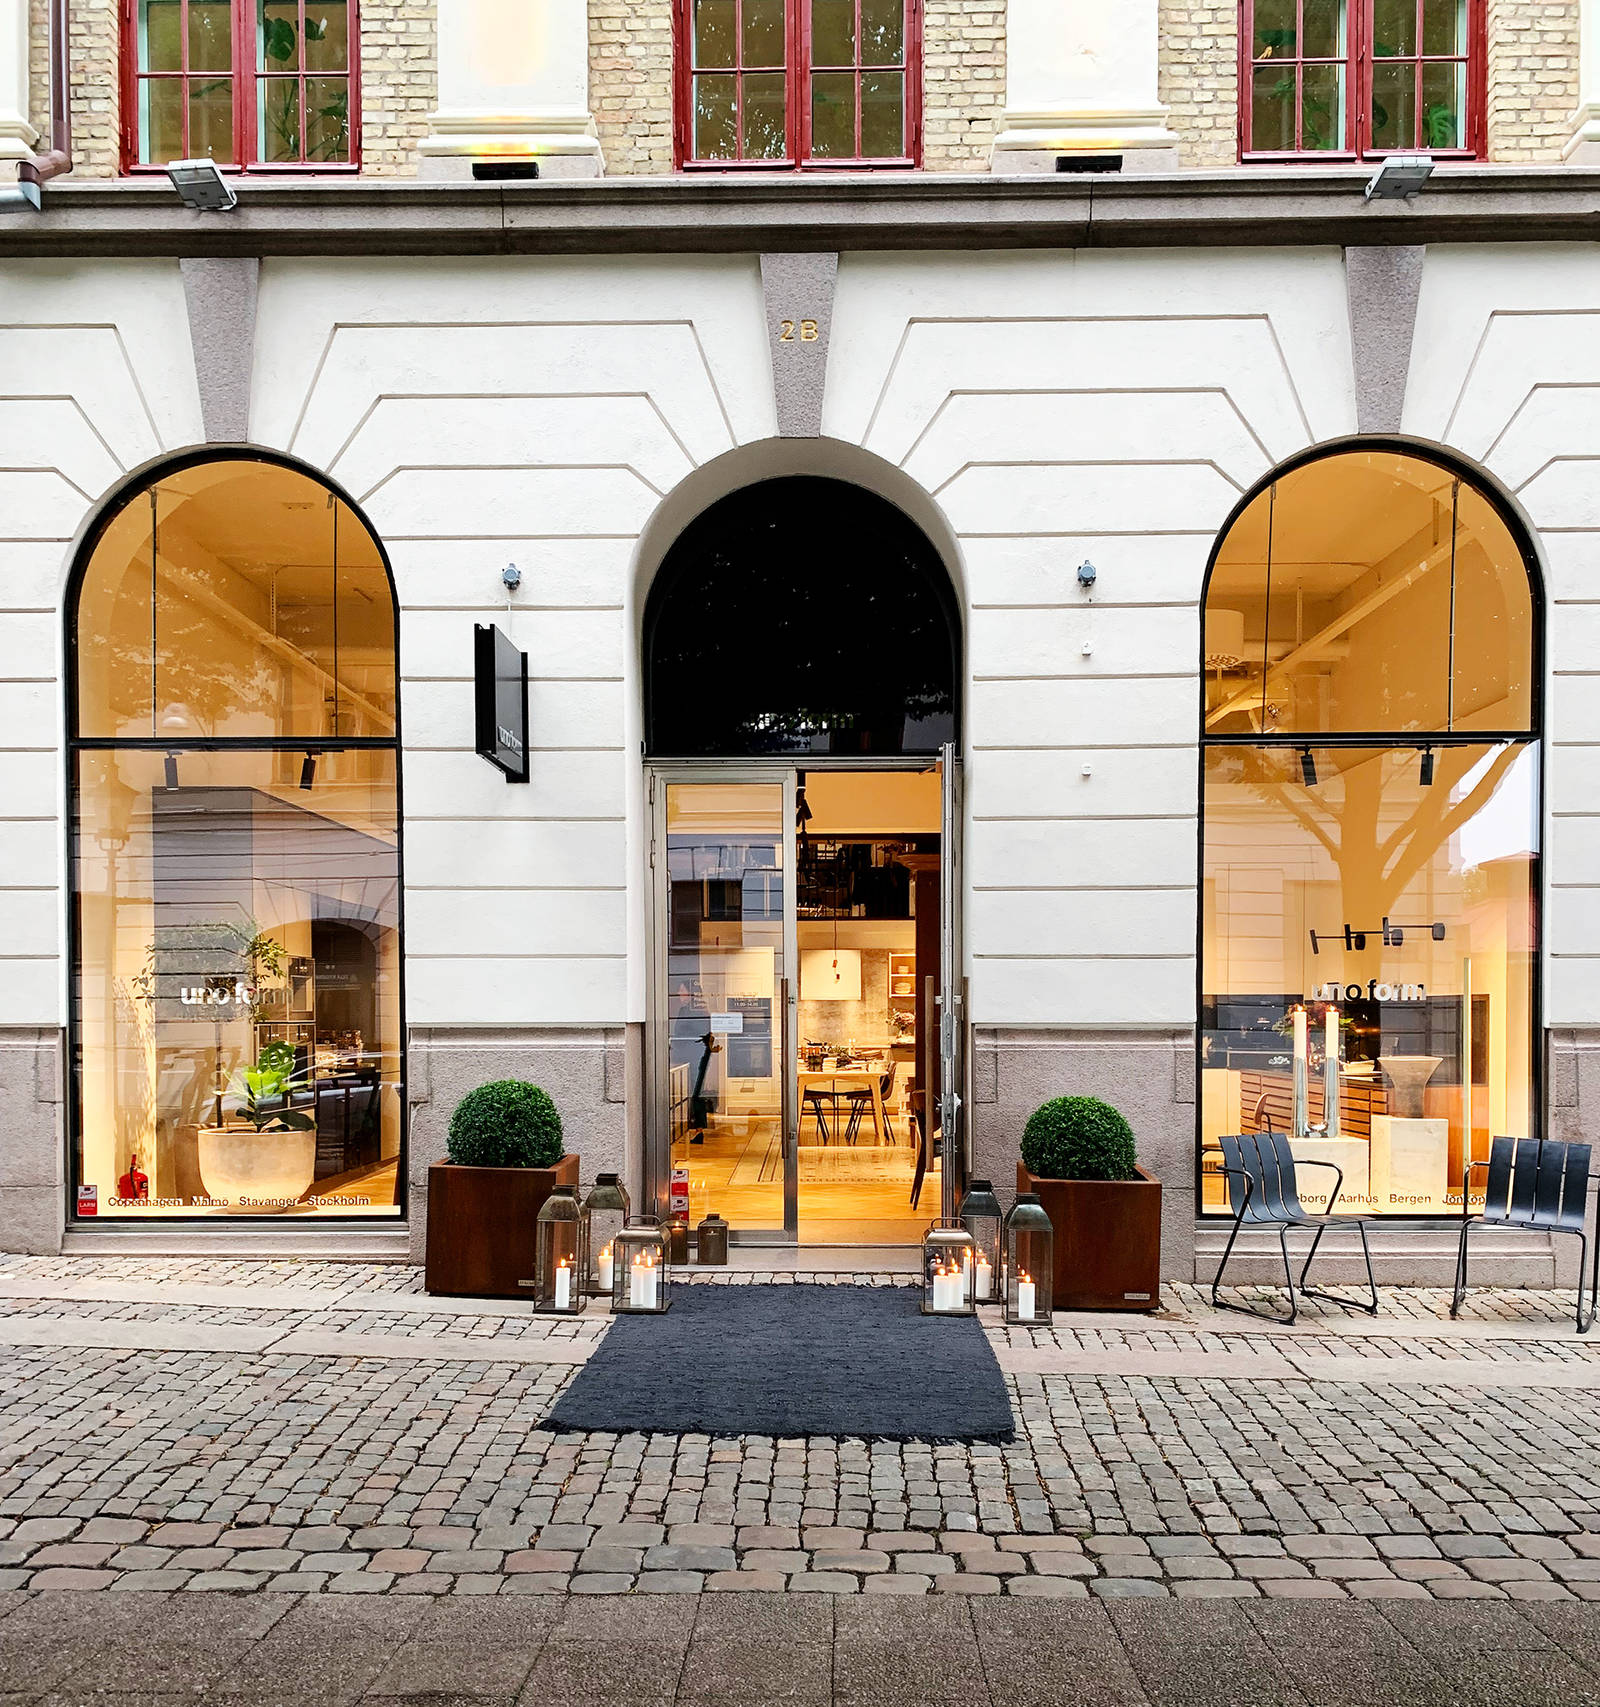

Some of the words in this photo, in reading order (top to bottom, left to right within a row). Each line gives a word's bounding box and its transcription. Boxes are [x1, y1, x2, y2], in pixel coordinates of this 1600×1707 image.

[779, 319, 819, 341] 2B
[179, 986, 231, 1005] uno
[233, 981, 294, 1005] form
[1312, 983, 1362, 1001] uno
[1366, 978, 1427, 1001] form
[107, 1196, 183, 1208] Copenhagen
[239, 1196, 298, 1207] Stavanger
[307, 1196, 370, 1206] Stockholm
[1297, 1193, 1328, 1205] borg
[1338, 1193, 1379, 1204] Aarhus
[1389, 1193, 1432, 1204] Bergen
